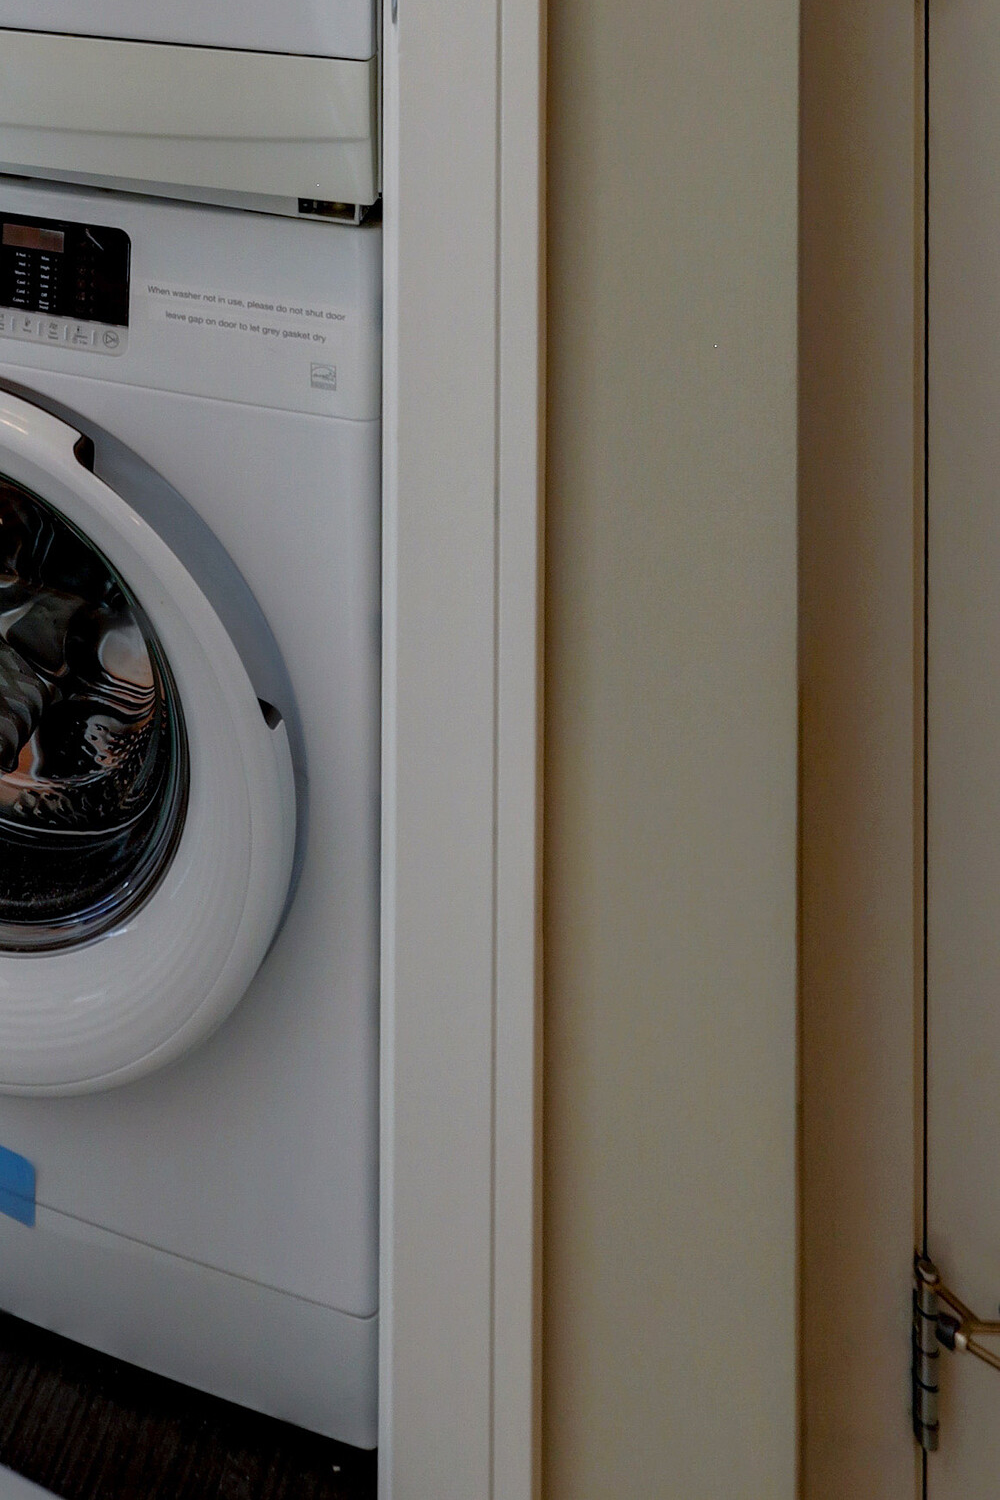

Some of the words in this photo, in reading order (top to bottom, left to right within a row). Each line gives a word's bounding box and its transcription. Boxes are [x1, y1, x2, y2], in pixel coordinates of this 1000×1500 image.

[147, 284, 170, 296] When
[172, 290, 202, 300] washer
[203, 294, 216, 302] not
[218, 296, 226, 304] in
[228, 298, 244, 308] use,
[247, 300, 274, 311] please
[276, 304, 288, 313] do
[289, 307, 304, 315] not
[305, 309, 324, 318] shut
[326, 312, 346, 321] door
[165, 310, 186, 320] leave
[188, 315, 204, 325] gap
[218, 320, 237, 328] door
[239, 322, 248, 331] to
[250, 324, 260, 332] let
[282, 330, 310, 340] gasket
[312, 334, 326, 344] dry
